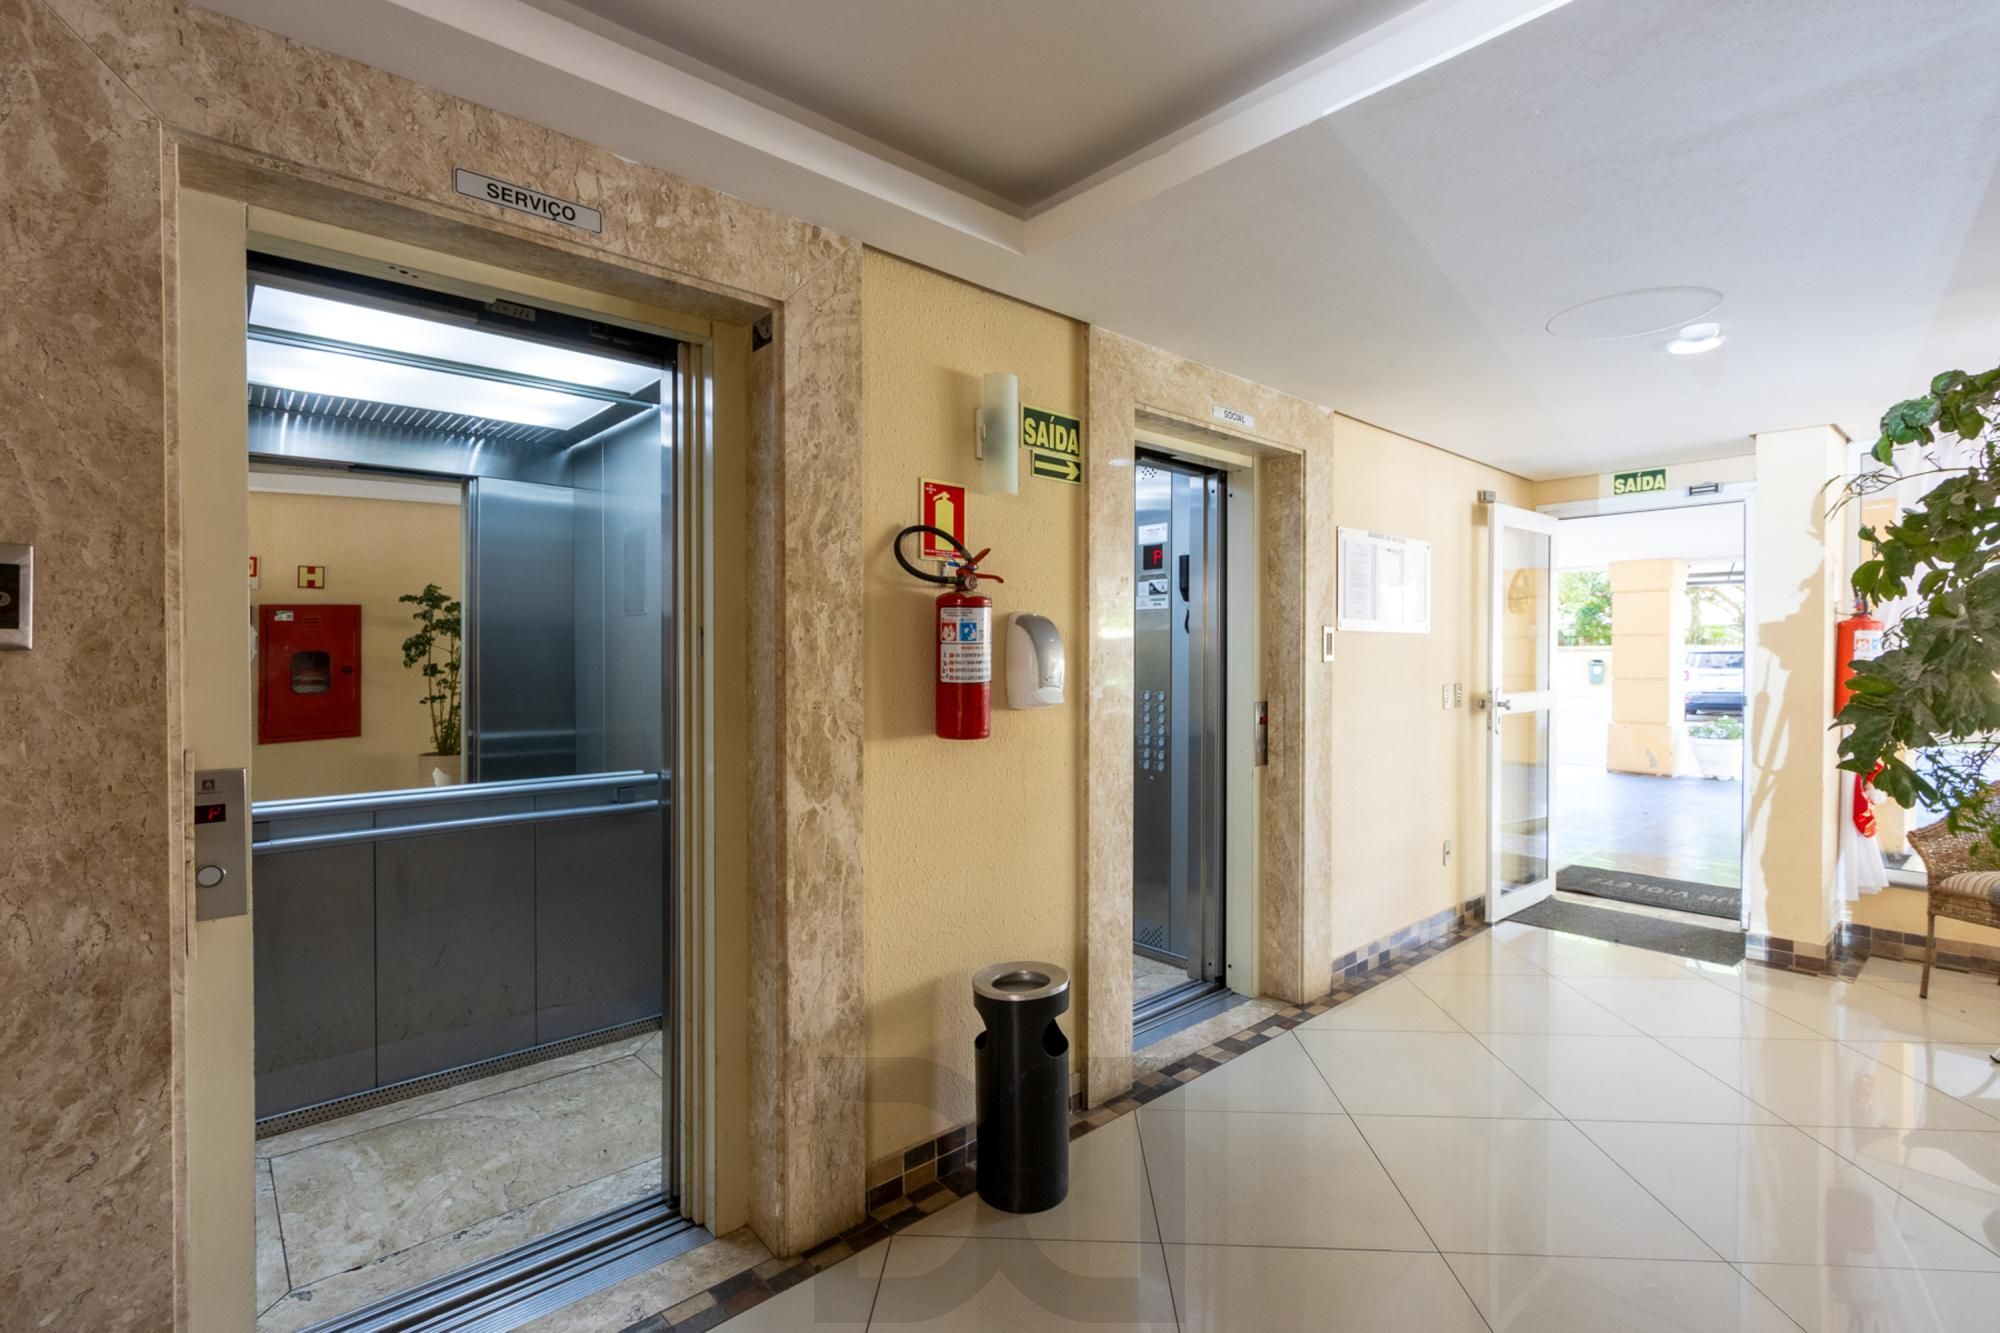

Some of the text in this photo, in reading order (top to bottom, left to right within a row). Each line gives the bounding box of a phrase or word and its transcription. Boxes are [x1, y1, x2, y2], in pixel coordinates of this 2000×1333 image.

[486, 182, 576, 221] SERVIÇO
[1224, 409, 1246, 424] SOCIAL
[1023, 415, 1080, 455] SAÍDA
[1614, 471, 1665, 494] SAÍDA
[1153, 549, 1163, 567] P
